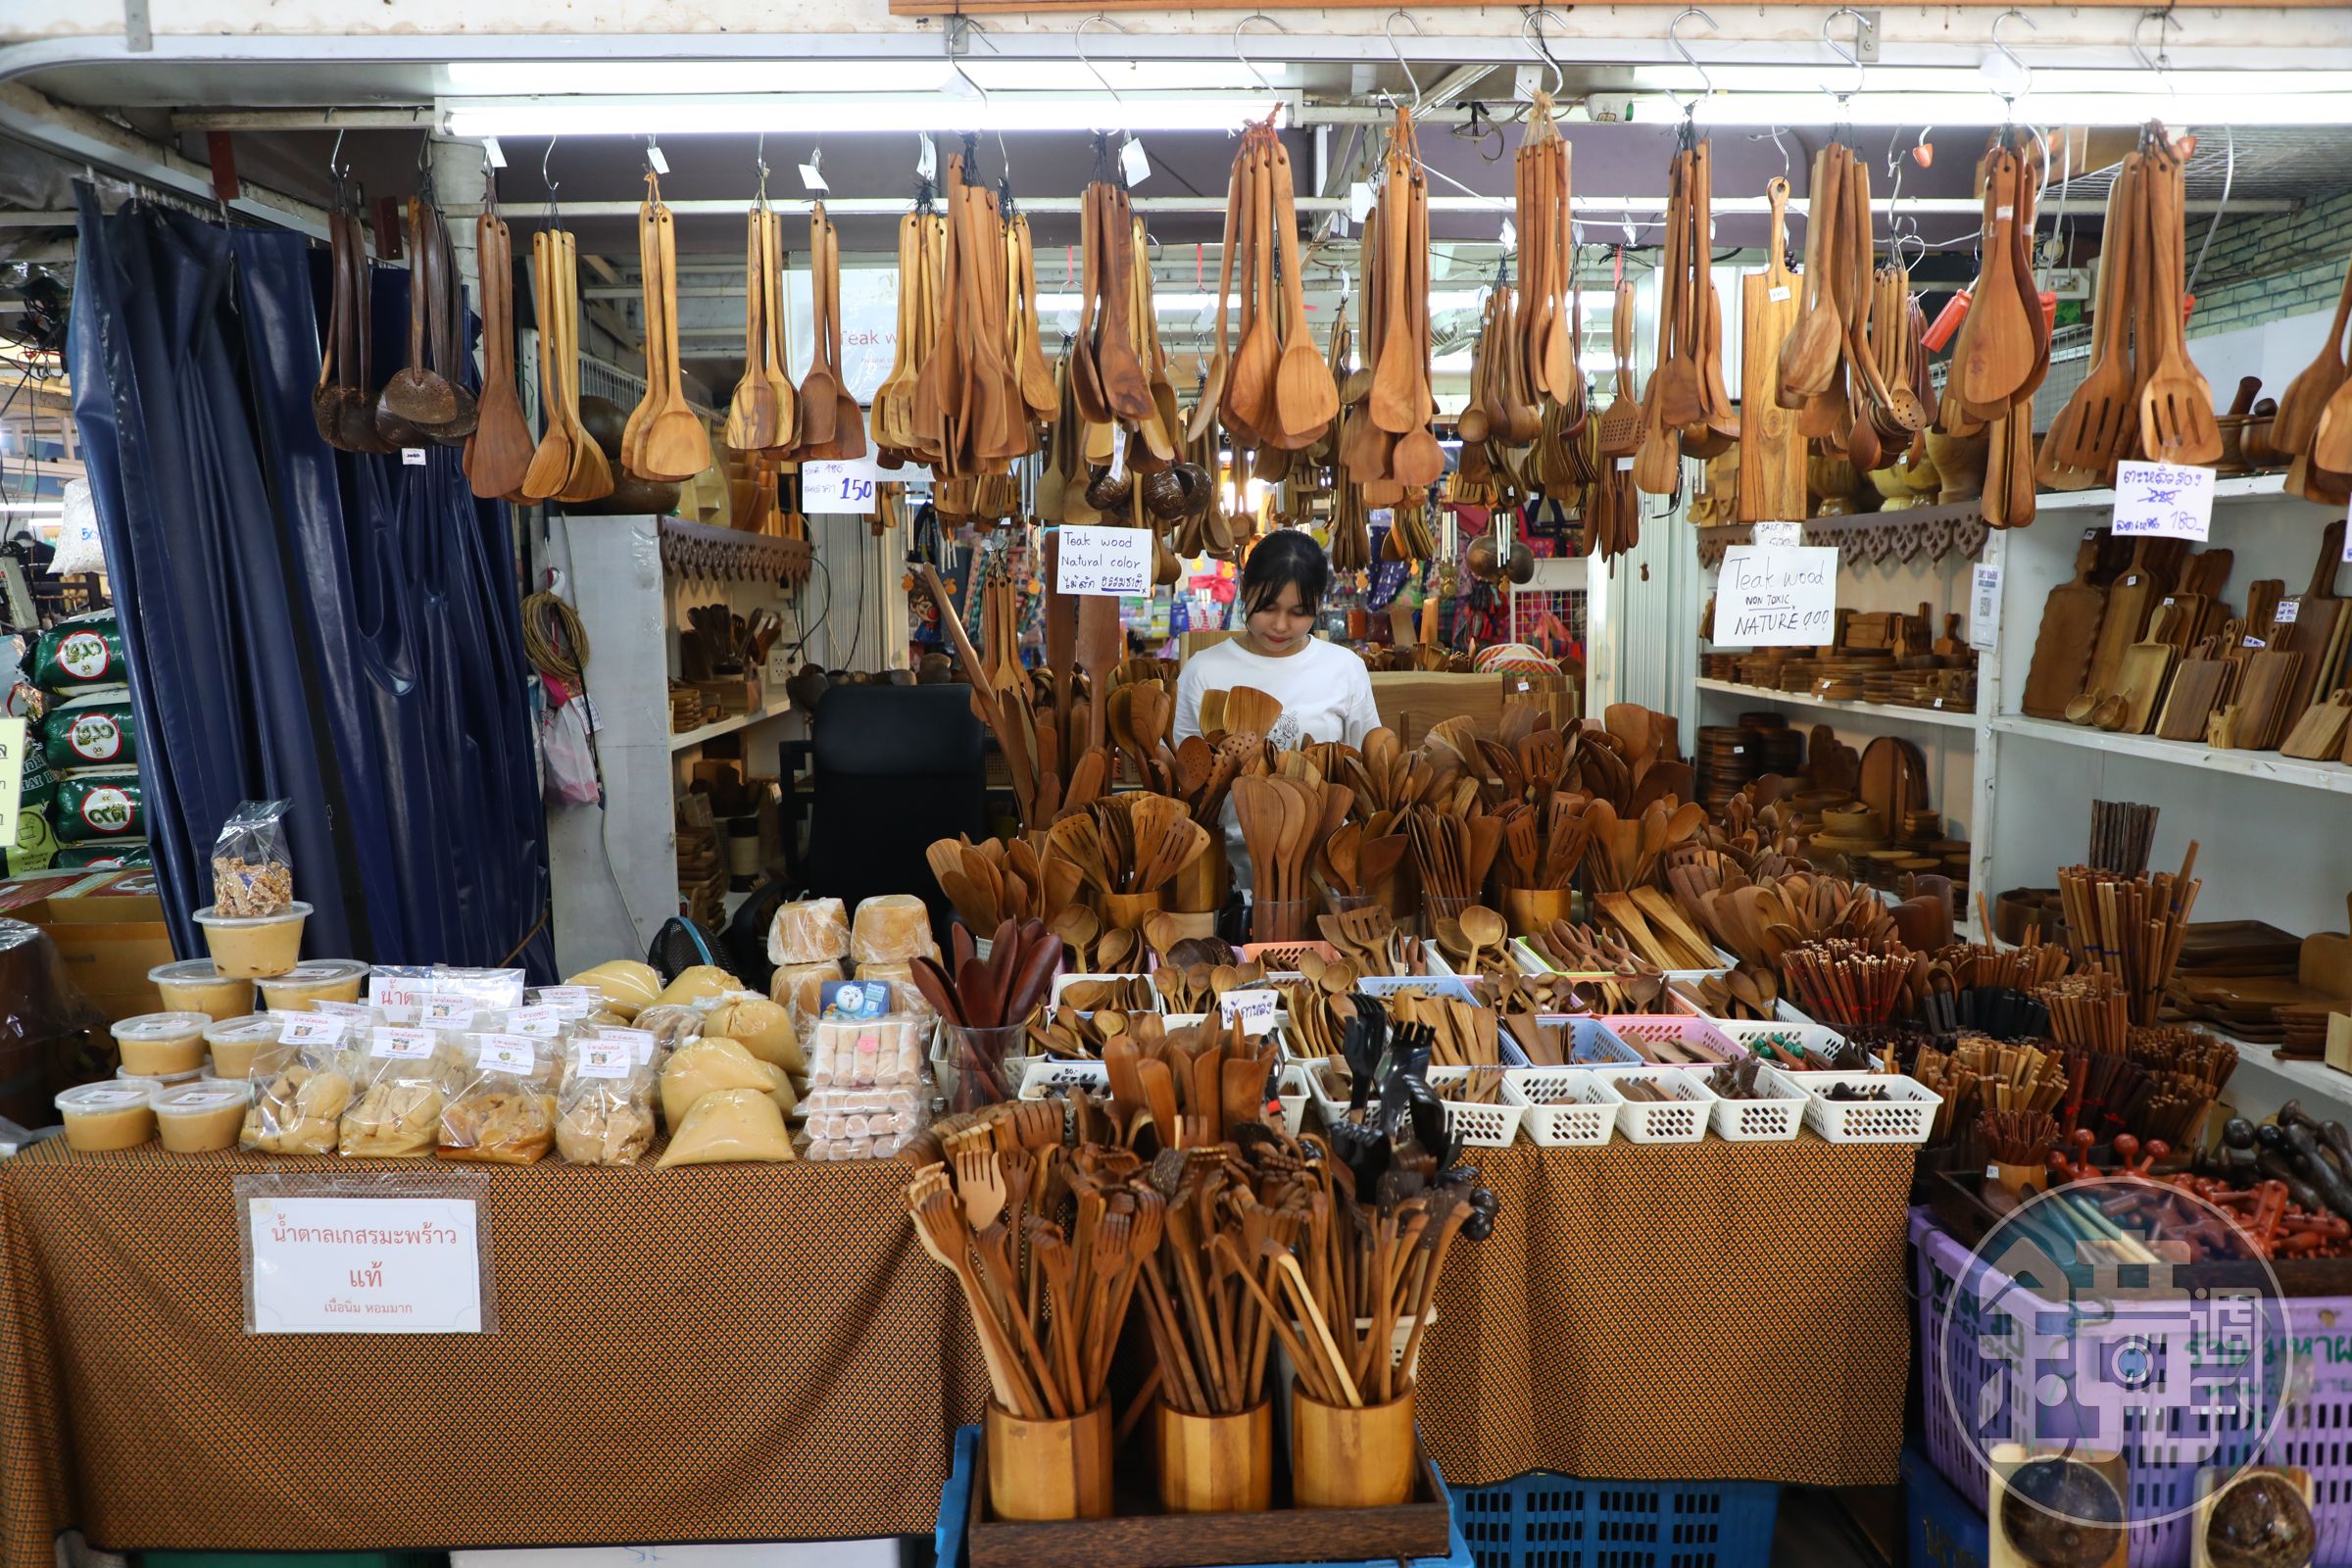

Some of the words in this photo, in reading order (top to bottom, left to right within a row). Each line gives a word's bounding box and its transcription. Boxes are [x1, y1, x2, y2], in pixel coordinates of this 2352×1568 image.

[840, 477, 872, 501] 150
[1064, 531, 1090, 546] Teak
[1101, 535, 1132, 548] wood
[1061, 554, 1102, 566] Natural
[1110, 555, 1141, 568] color
[1730, 557, 1774, 590] Teak
[1784, 560, 1824, 588] wood
[1745, 596, 1763, 606] NON
[1767, 594, 1789, 606] TOXIC
[1735, 612, 1798, 635] NATURE
[271, 1213, 458, 1246] น้ำตาลเกสรมะพร้าว
[349, 1260, 383, 1288] แท้
[365, 1303, 413, 1315] หอมมาก
